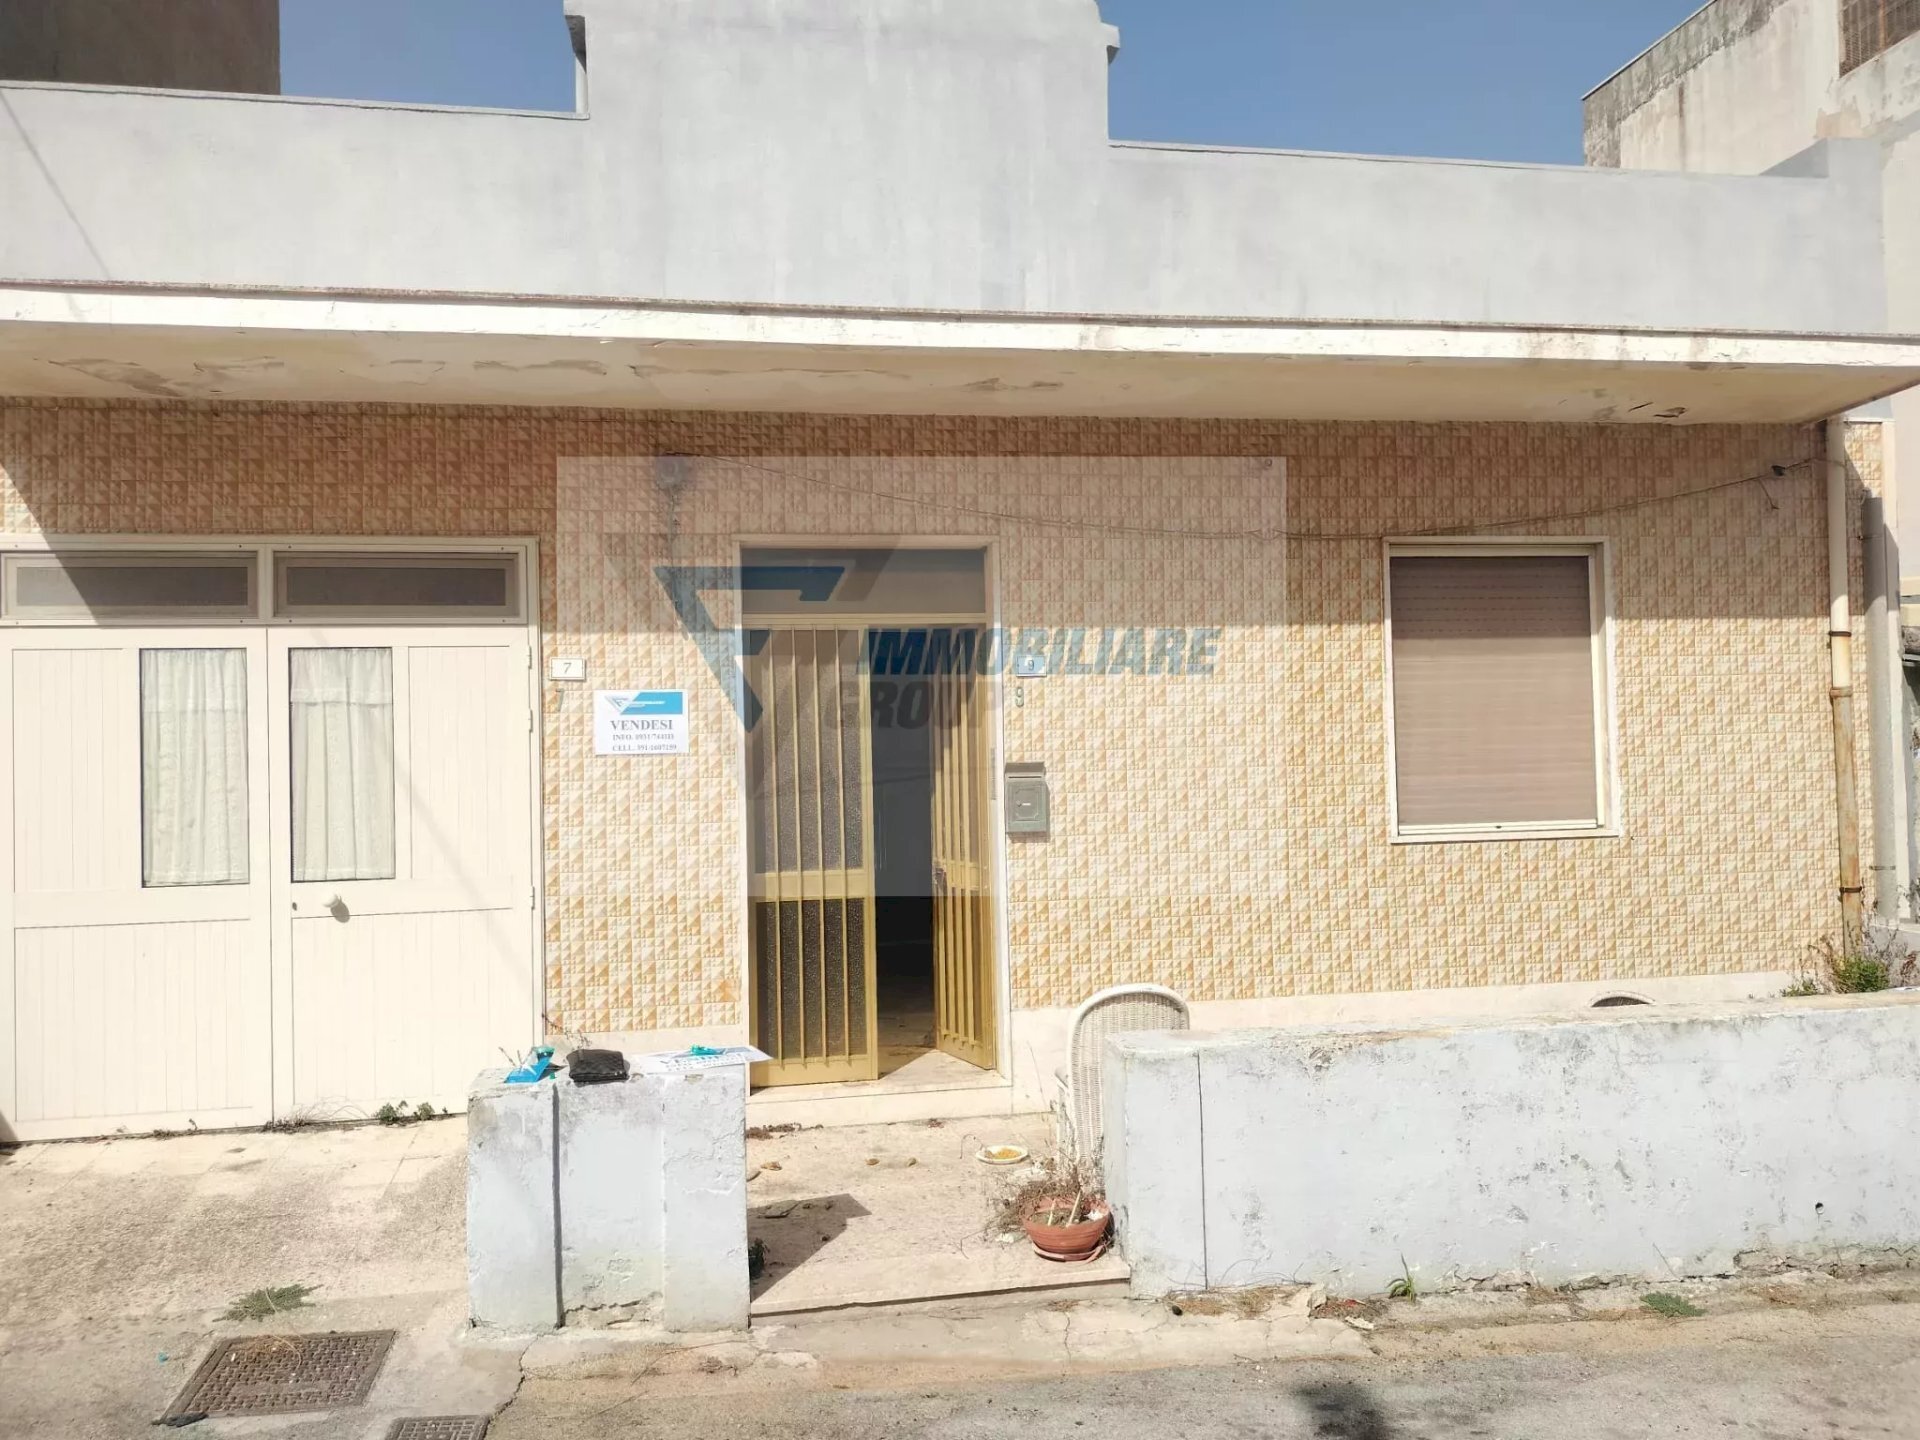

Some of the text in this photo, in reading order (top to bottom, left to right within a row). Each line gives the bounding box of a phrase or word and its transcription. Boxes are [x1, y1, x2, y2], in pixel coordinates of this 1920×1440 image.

[563, 662, 572, 674] 7
[1027, 659, 1035, 670] 9
[1015, 687, 1024, 707] 9
[610, 719, 673, 731] VENDESI
